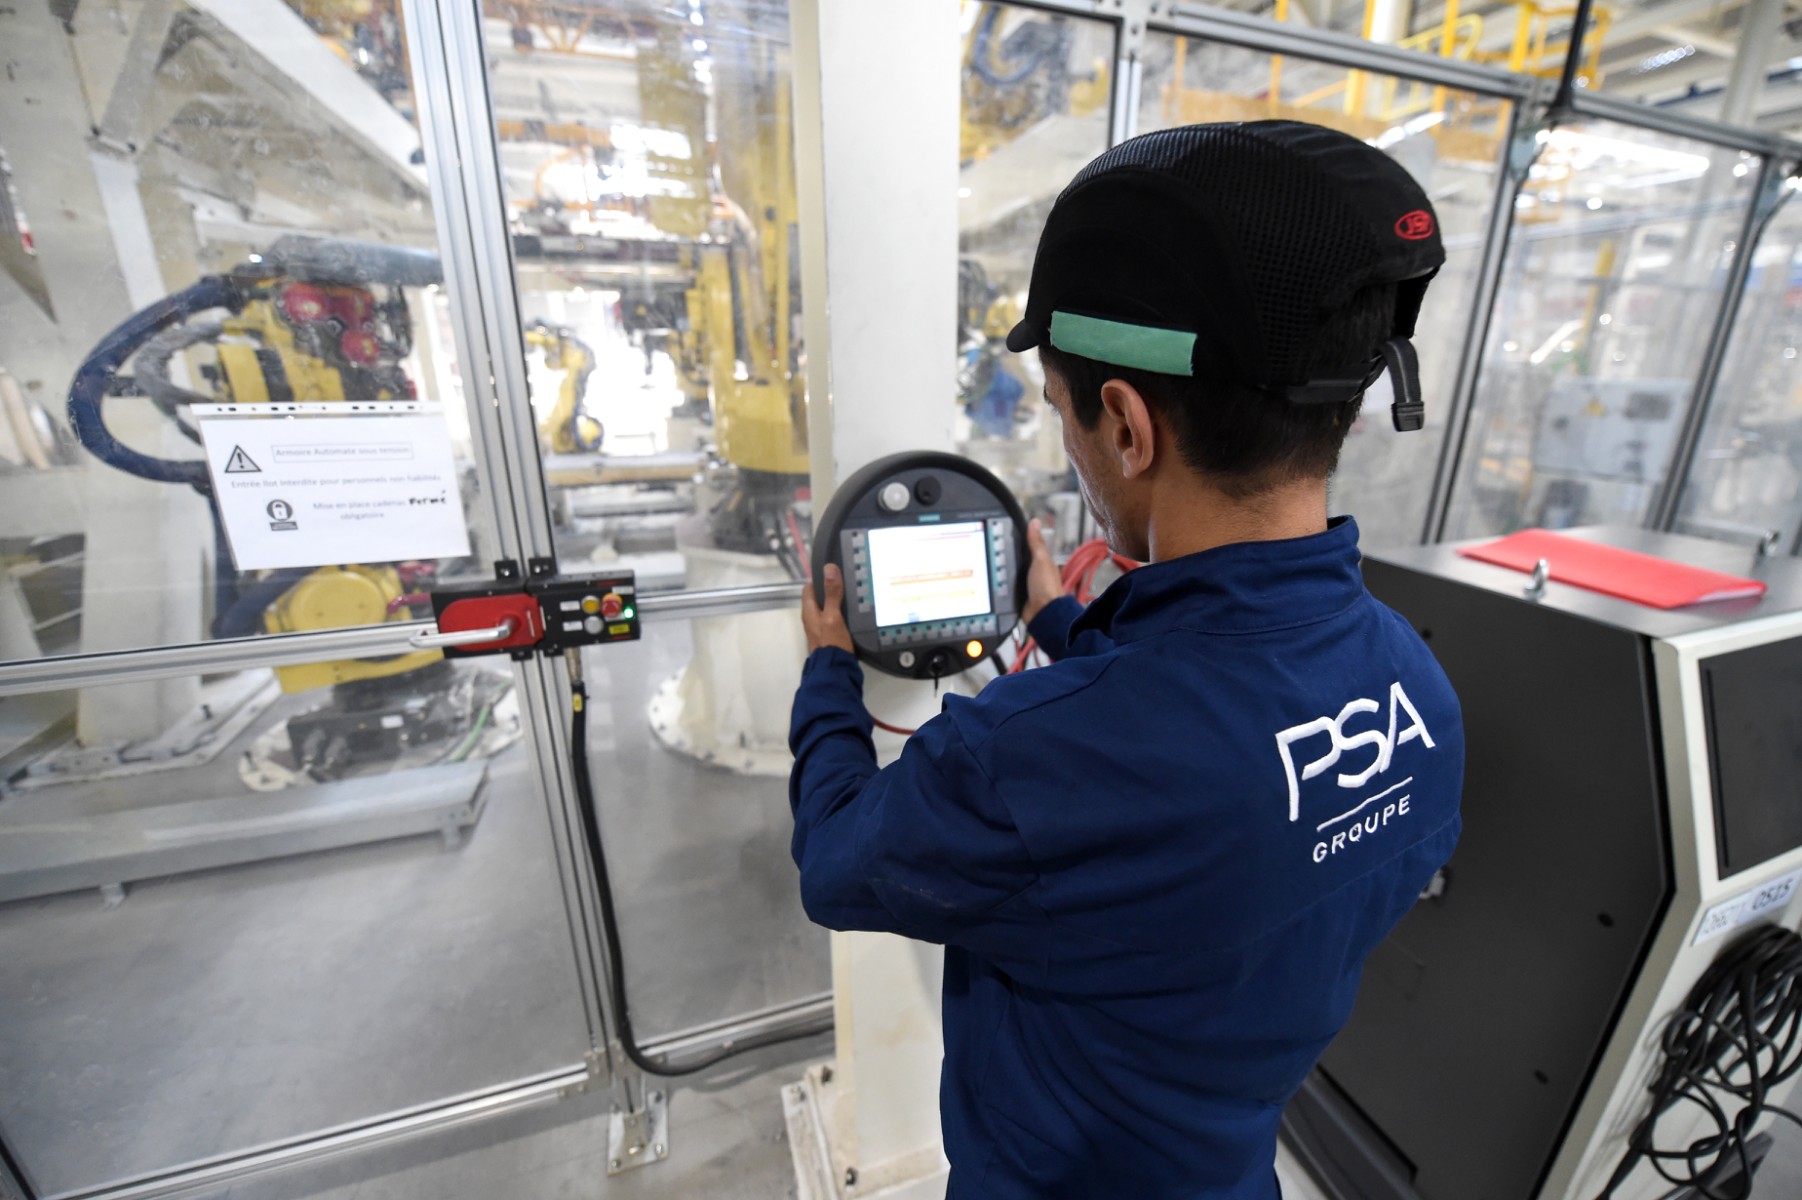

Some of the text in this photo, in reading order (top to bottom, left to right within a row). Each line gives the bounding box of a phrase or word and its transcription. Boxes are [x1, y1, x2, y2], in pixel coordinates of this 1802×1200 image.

[276, 448, 311, 456] Armoire
[314, 447, 355, 456] Automate
[231, 479, 261, 488] Entrée
[320, 478, 339, 486] pour
[342, 476, 387, 485] personnels
[348, 501, 371, 509] place
[373, 499, 406, 507] cadenas
[1275, 682, 1436, 822] PSA
[1312, 794, 1411, 863] GROUPE
